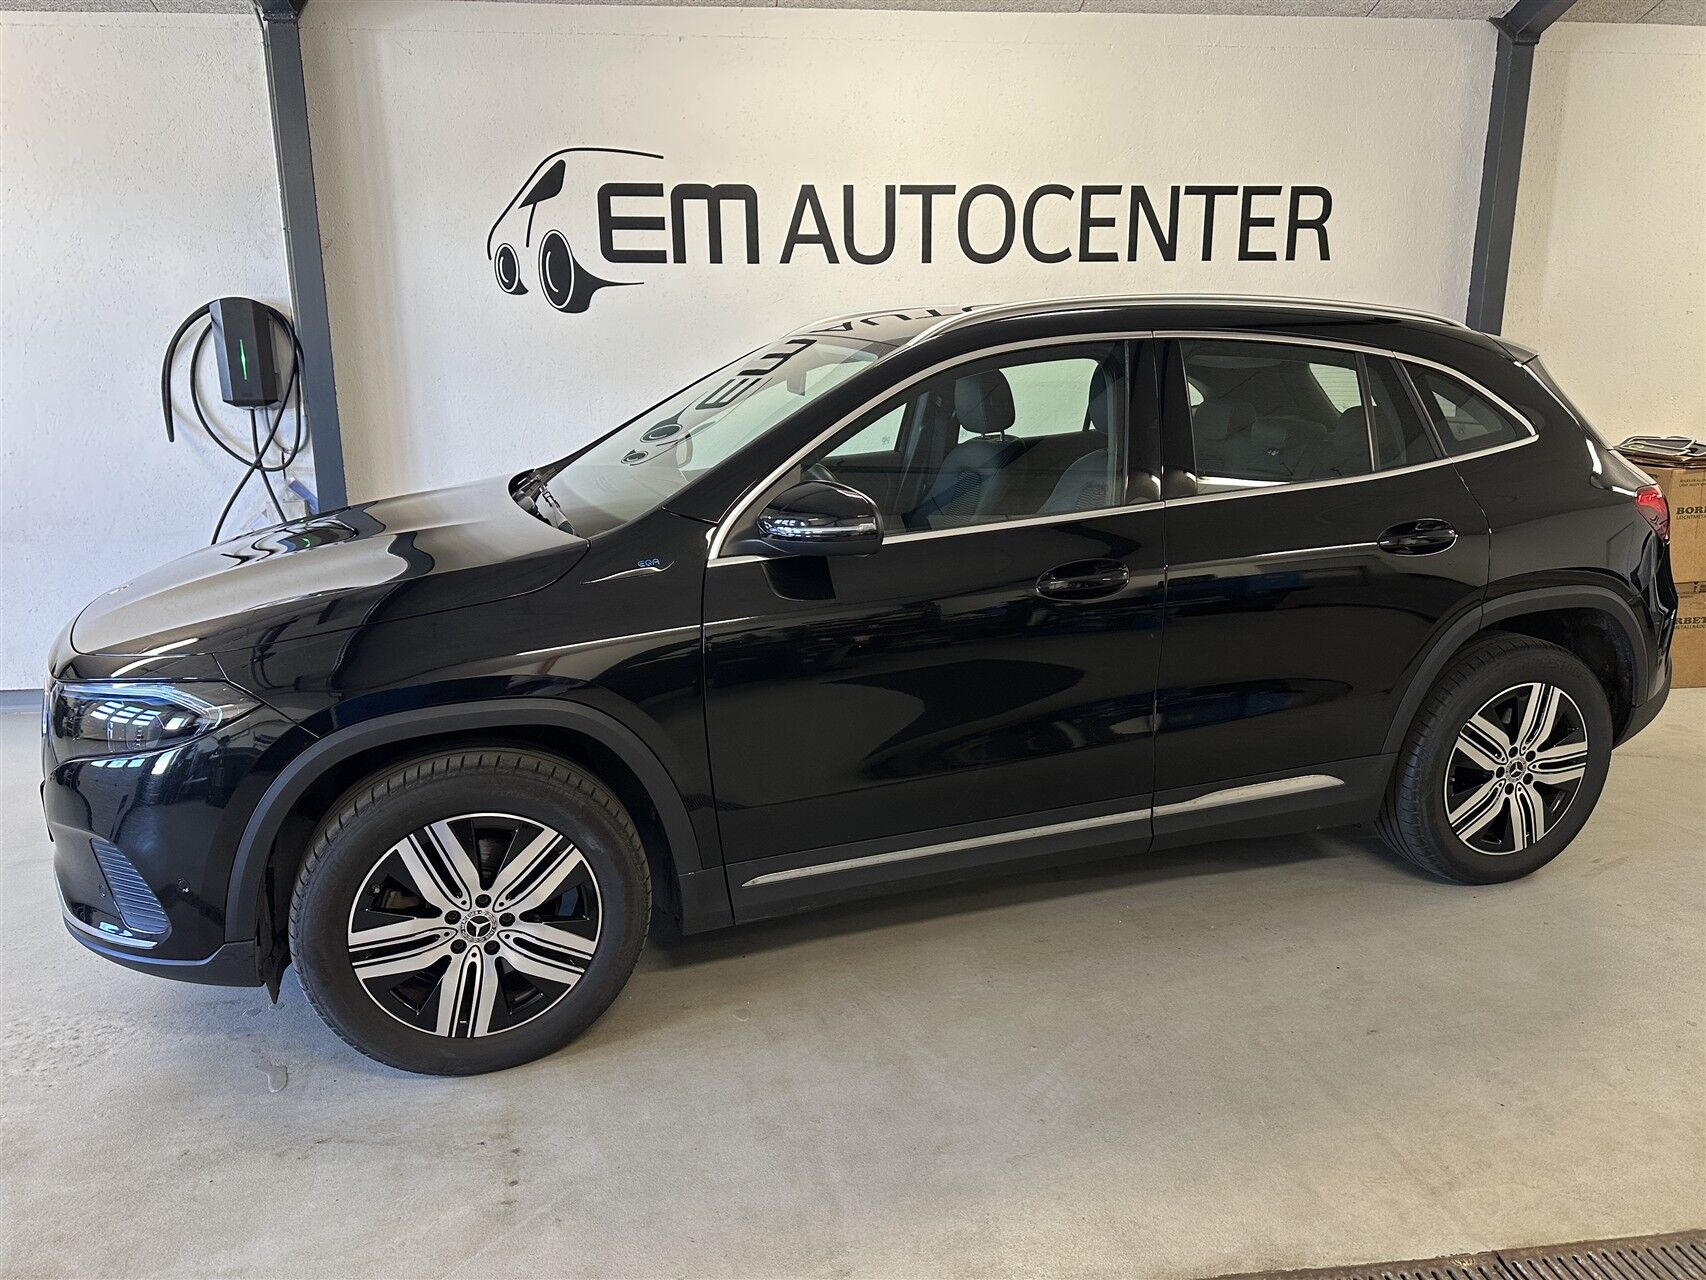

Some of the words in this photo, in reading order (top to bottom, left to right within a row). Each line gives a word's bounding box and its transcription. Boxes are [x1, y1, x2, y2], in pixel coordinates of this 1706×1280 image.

[597, 182, 759, 264] EM
[780, 184, 1332, 264] AUTOCENTER
[1676, 506, 1706, 515] BOR
[637, 558, 660, 567] EQA
